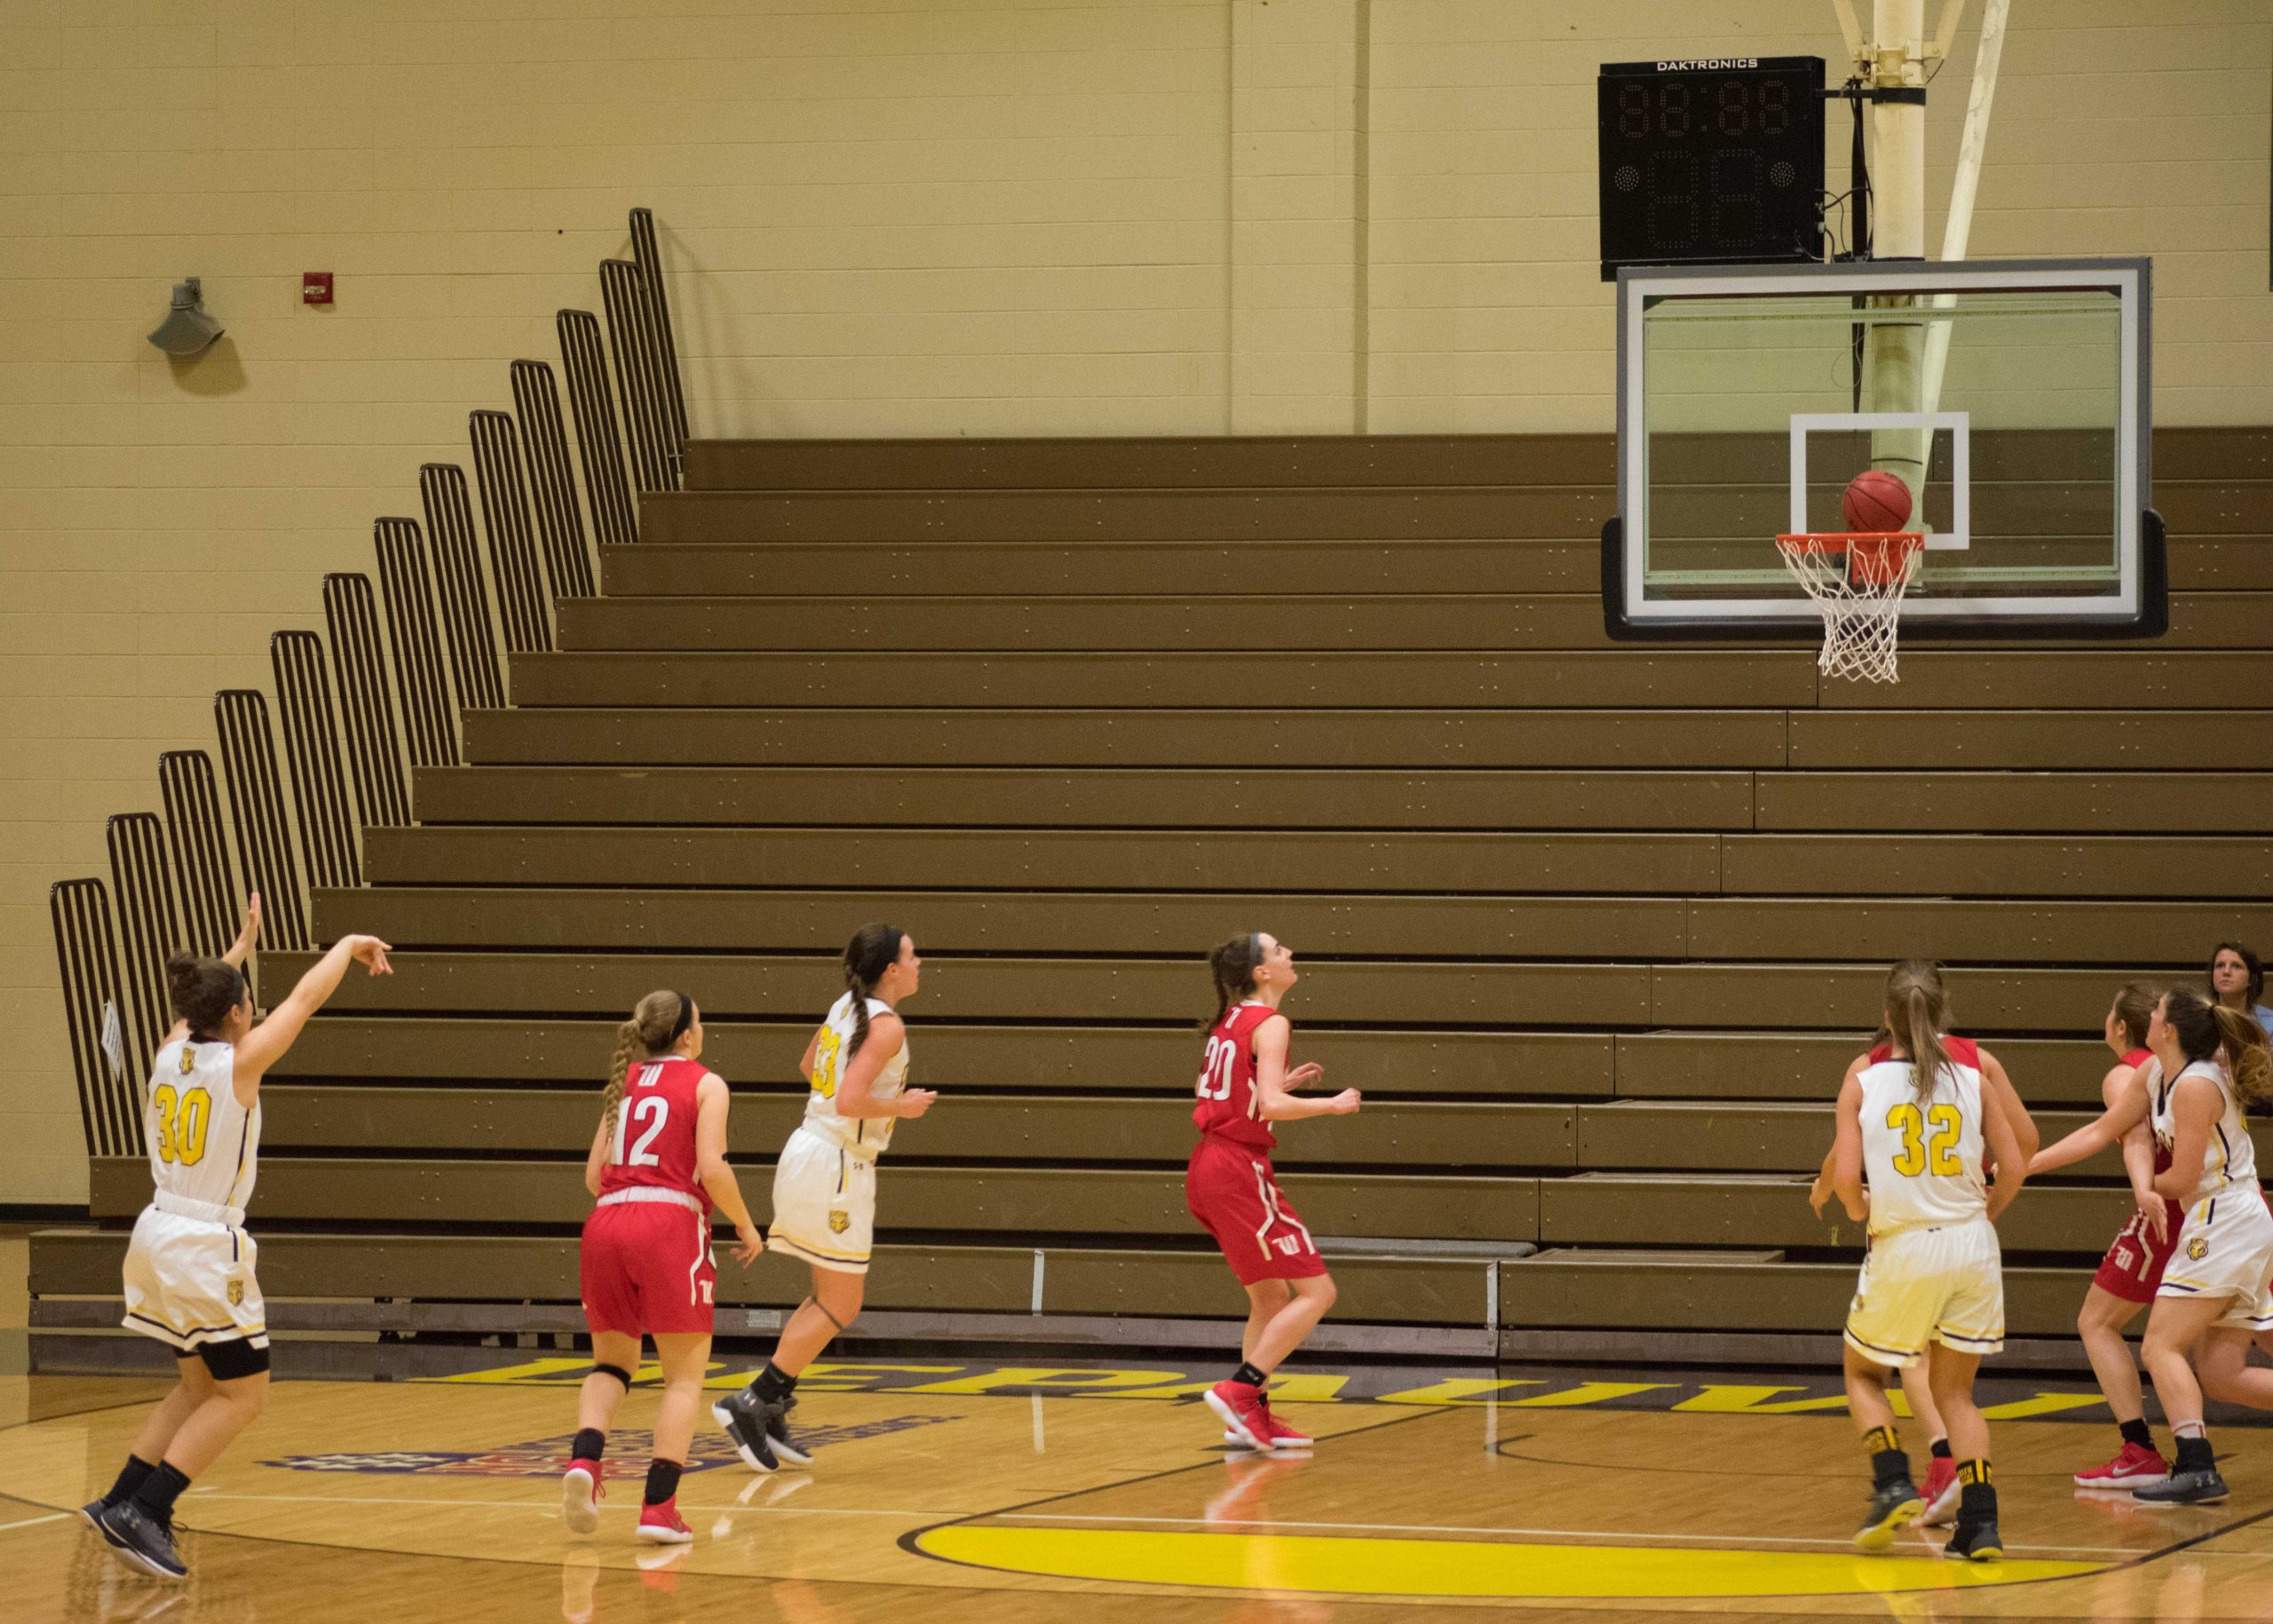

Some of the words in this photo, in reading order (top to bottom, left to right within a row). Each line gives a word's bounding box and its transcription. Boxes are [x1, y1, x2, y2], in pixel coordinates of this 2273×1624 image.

[1657, 59, 1758, 71] DAKTRONICS
[1198, 1035, 1236, 1101] 20
[154, 1083, 212, 1167] 30
[610, 1096, 669, 1167] 12
[1886, 1103, 1963, 1176] 32
